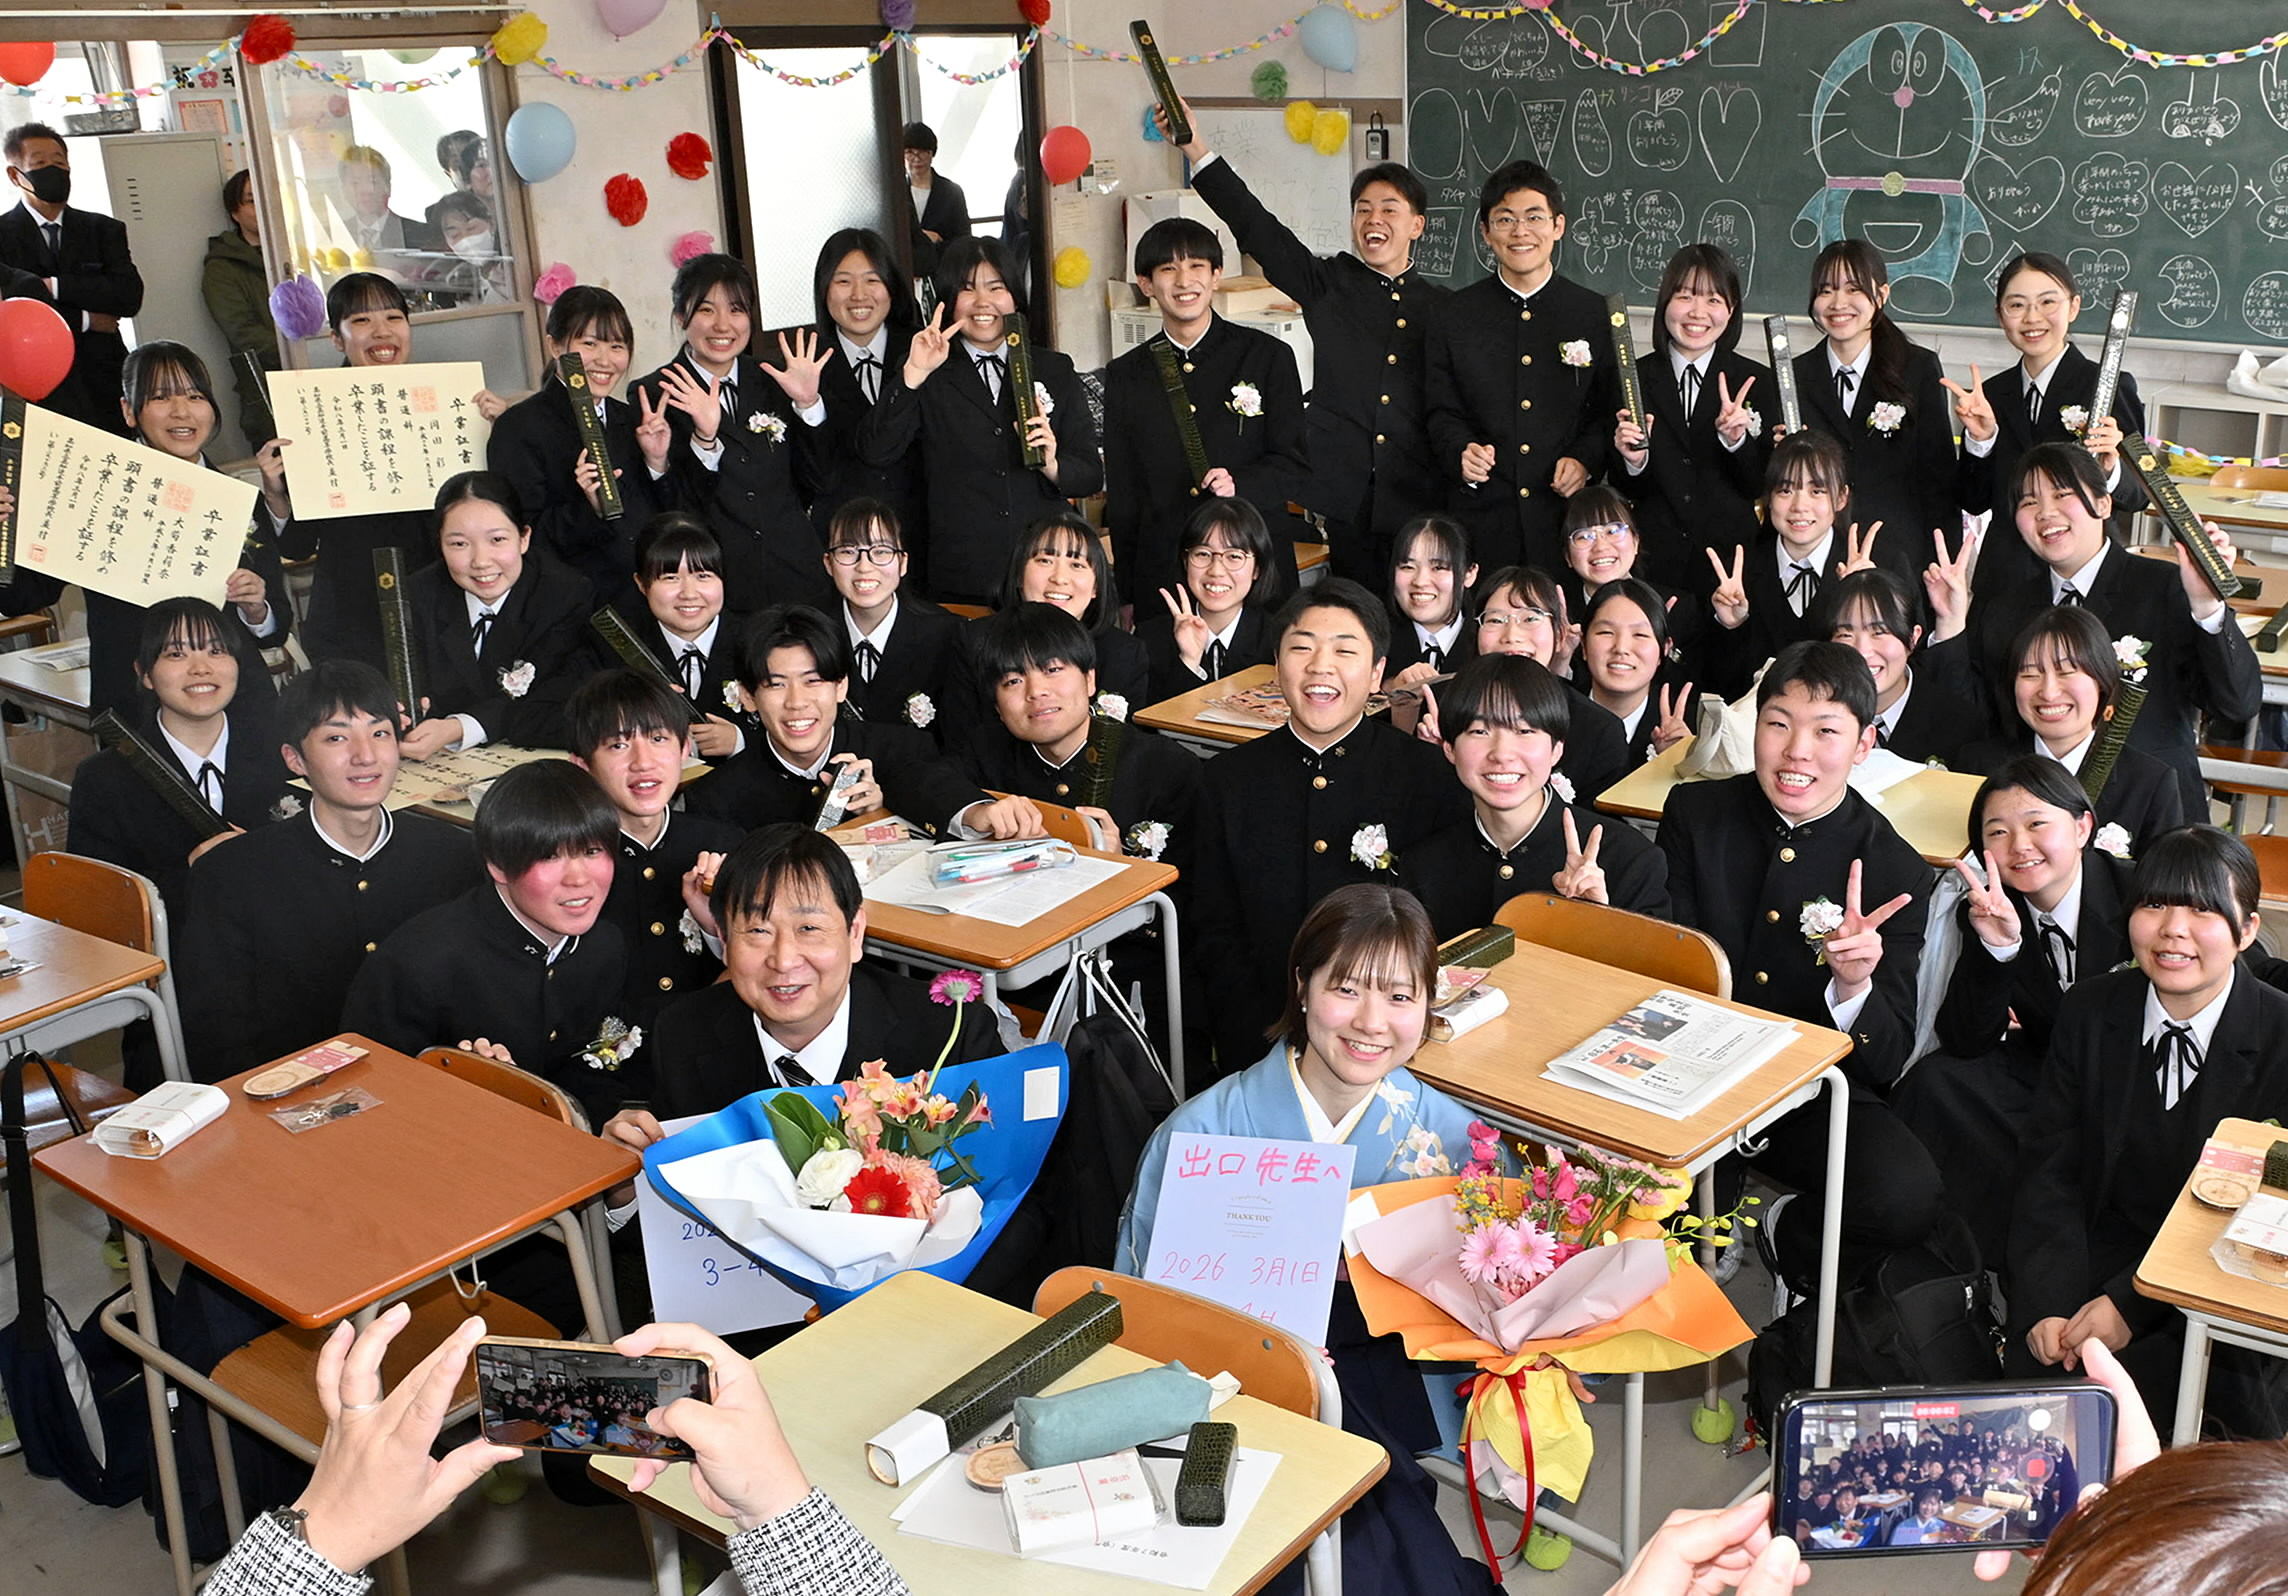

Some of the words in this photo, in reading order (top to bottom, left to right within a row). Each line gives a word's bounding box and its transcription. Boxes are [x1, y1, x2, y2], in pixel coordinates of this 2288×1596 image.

[1621, 84, 1653, 103] リンゴ
[2083, 96, 2108, 110] very
[2111, 95, 2136, 107] very
[1208, 119, 1263, 163] 卒業
[397, 388, 413, 432] 普通科
[450, 397, 472, 464] 卒業証書
[348, 384, 376, 492] 卒業したことを証する
[370, 383, 403, 494] 頭書の課程を修め
[75, 451, 119, 562] 卒業したことを証する
[97, 460, 143, 575] 頭書の課程を修め
[143, 477, 164, 522] 普通科
[190, 508, 223, 577] 卒業証書
[1178, 1143, 1342, 1187] 出口先生へ
[1226, 1212, 1254, 1222] THANK
[1254, 1213, 1273, 1223] YOU
[1160, 1251, 1228, 1282] 2026
[1249, 1256, 1321, 1287] 3月1日
